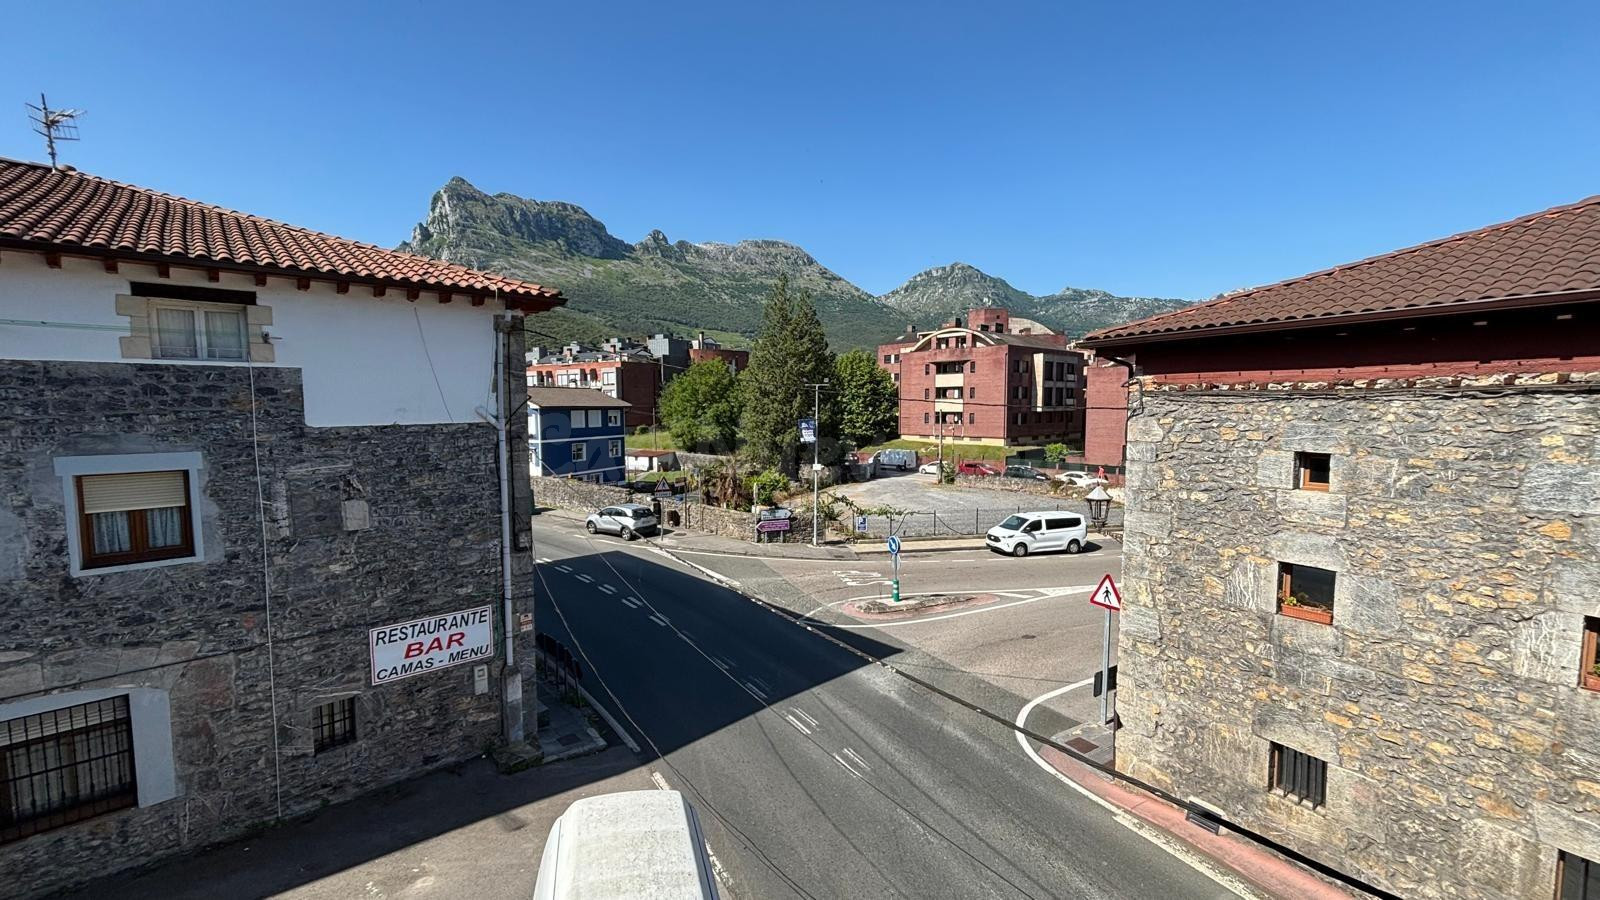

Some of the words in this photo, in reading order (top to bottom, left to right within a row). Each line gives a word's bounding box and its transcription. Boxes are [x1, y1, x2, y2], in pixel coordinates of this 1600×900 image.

[375, 609, 488, 646] RESTAURANTE
[403, 632, 466, 659] BAR
[376, 657, 434, 681] CAMAS
[448, 644, 489, 663] MENU
